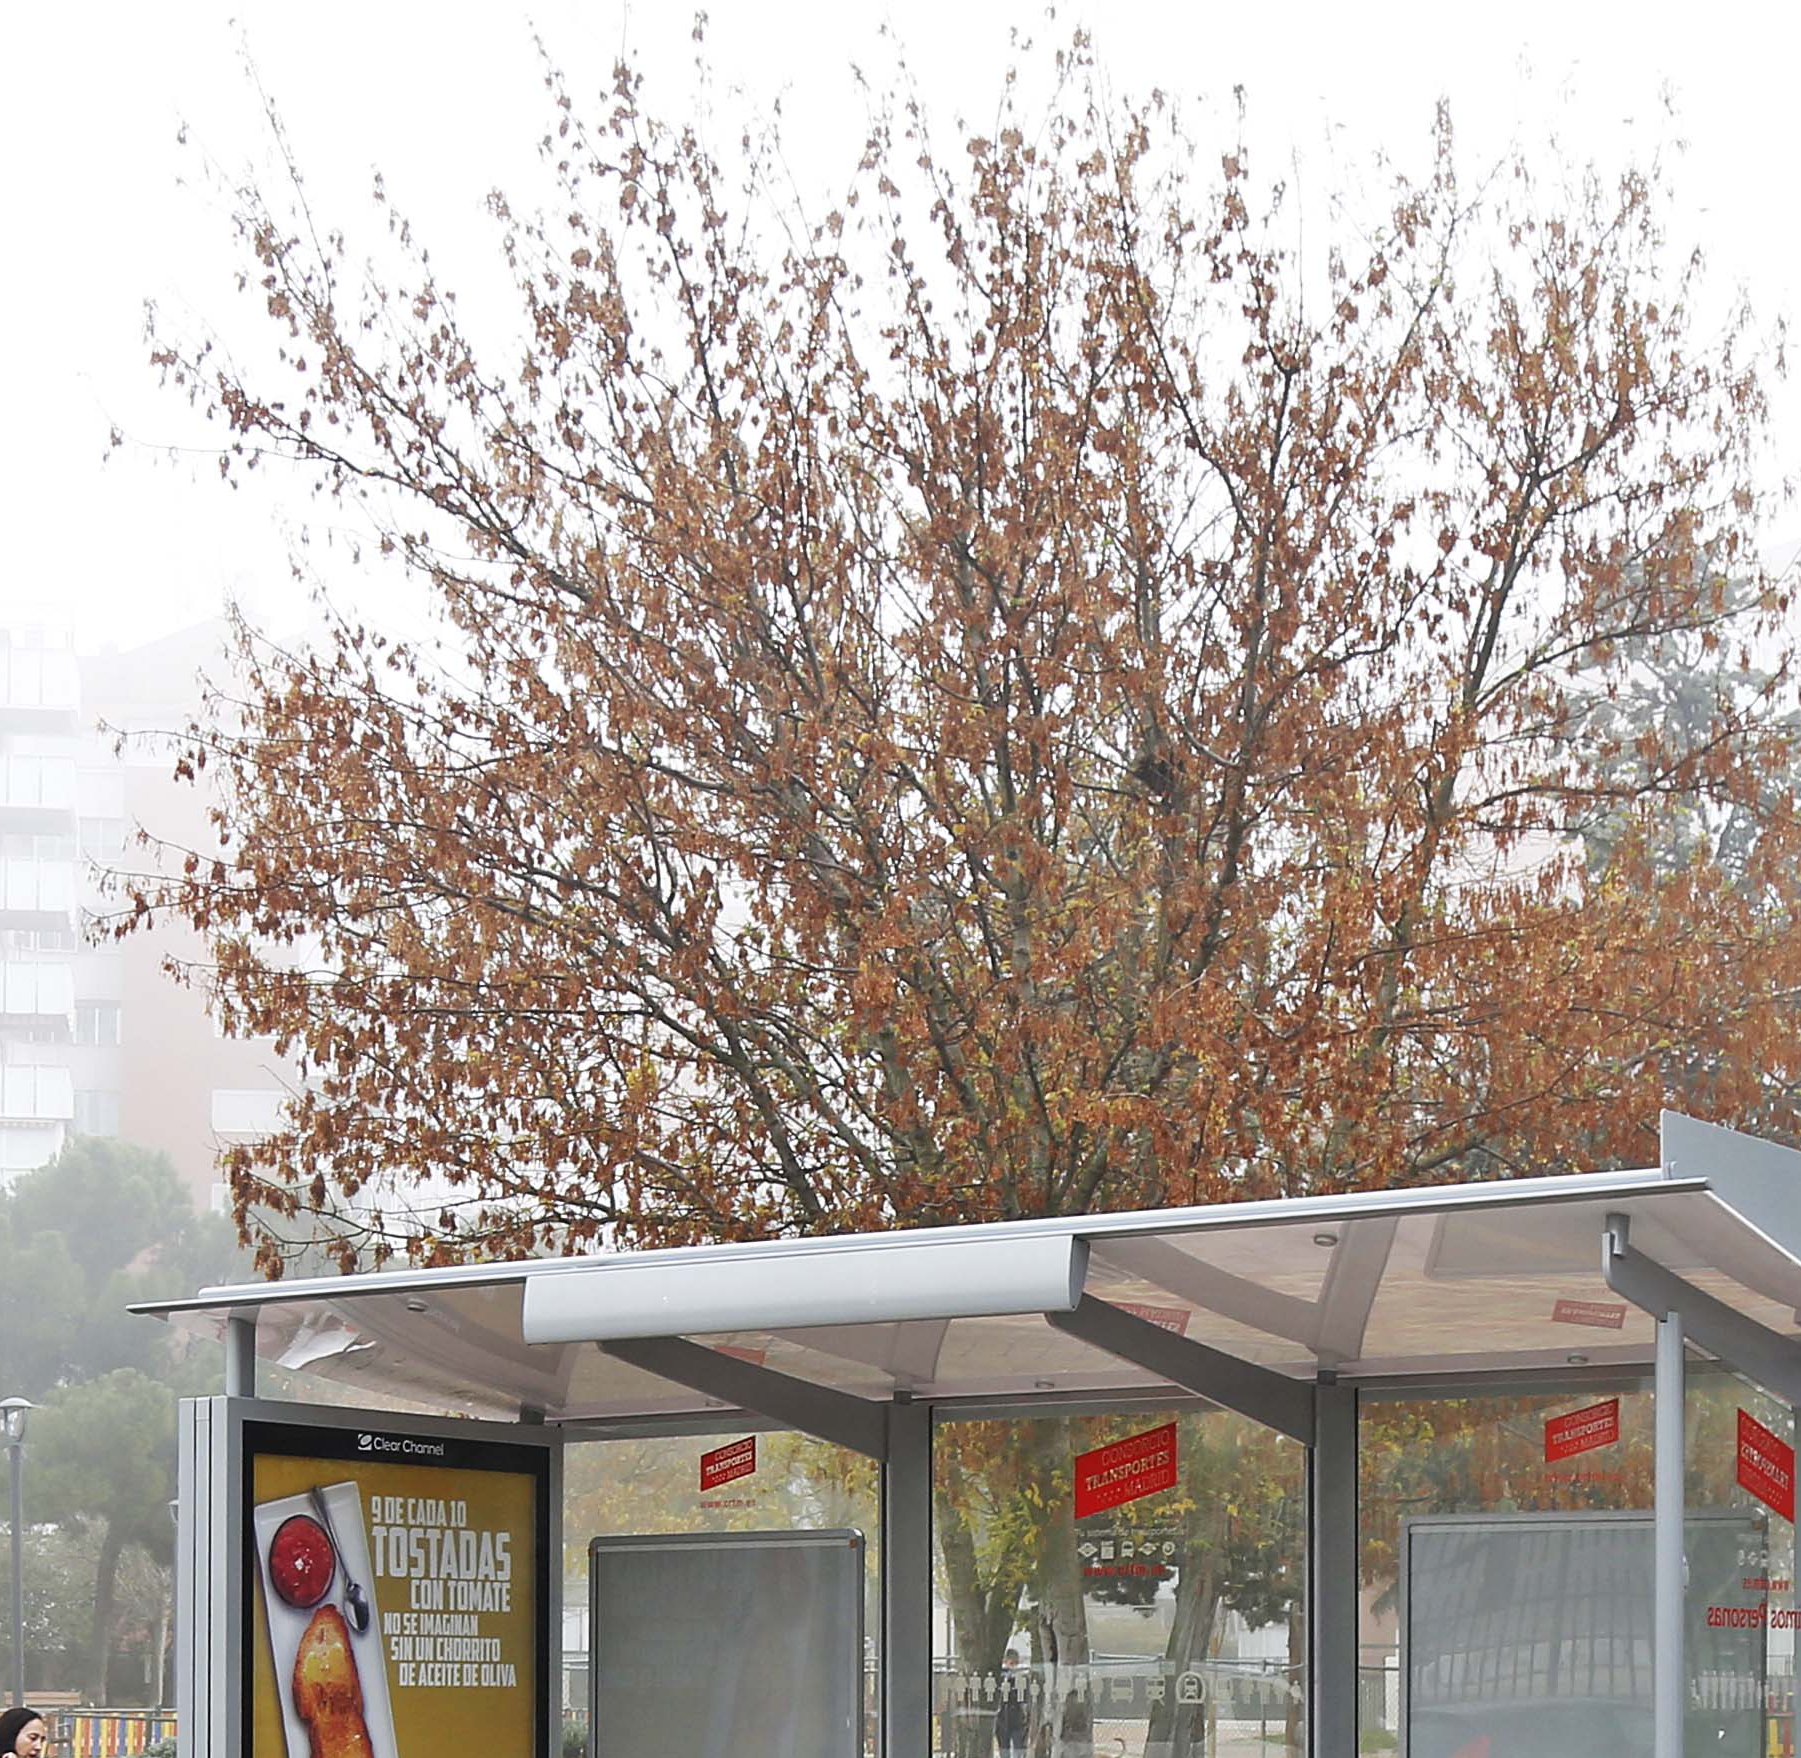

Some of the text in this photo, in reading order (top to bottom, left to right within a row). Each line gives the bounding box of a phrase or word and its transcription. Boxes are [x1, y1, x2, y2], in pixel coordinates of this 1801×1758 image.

[373, 1437, 445, 1456] Clear Channel
[1101, 1430, 1171, 1467] CONSORCIO
[1085, 1450, 1171, 1492] TRANSPORTES
[1123, 1469, 1170, 1498] MADRID
[371, 1495, 467, 1528] 9 DE CADA 10
[371, 1525, 511, 1582] TOSTADAS
[410, 1579, 511, 1613] CON TOMATE
[383, 1612, 479, 1637] NO SE IMAGINAN
[390, 1637, 502, 1662] SIN UN CHORRITO
[399, 1663, 517, 1687] DE ACEITE DE OLIVA
